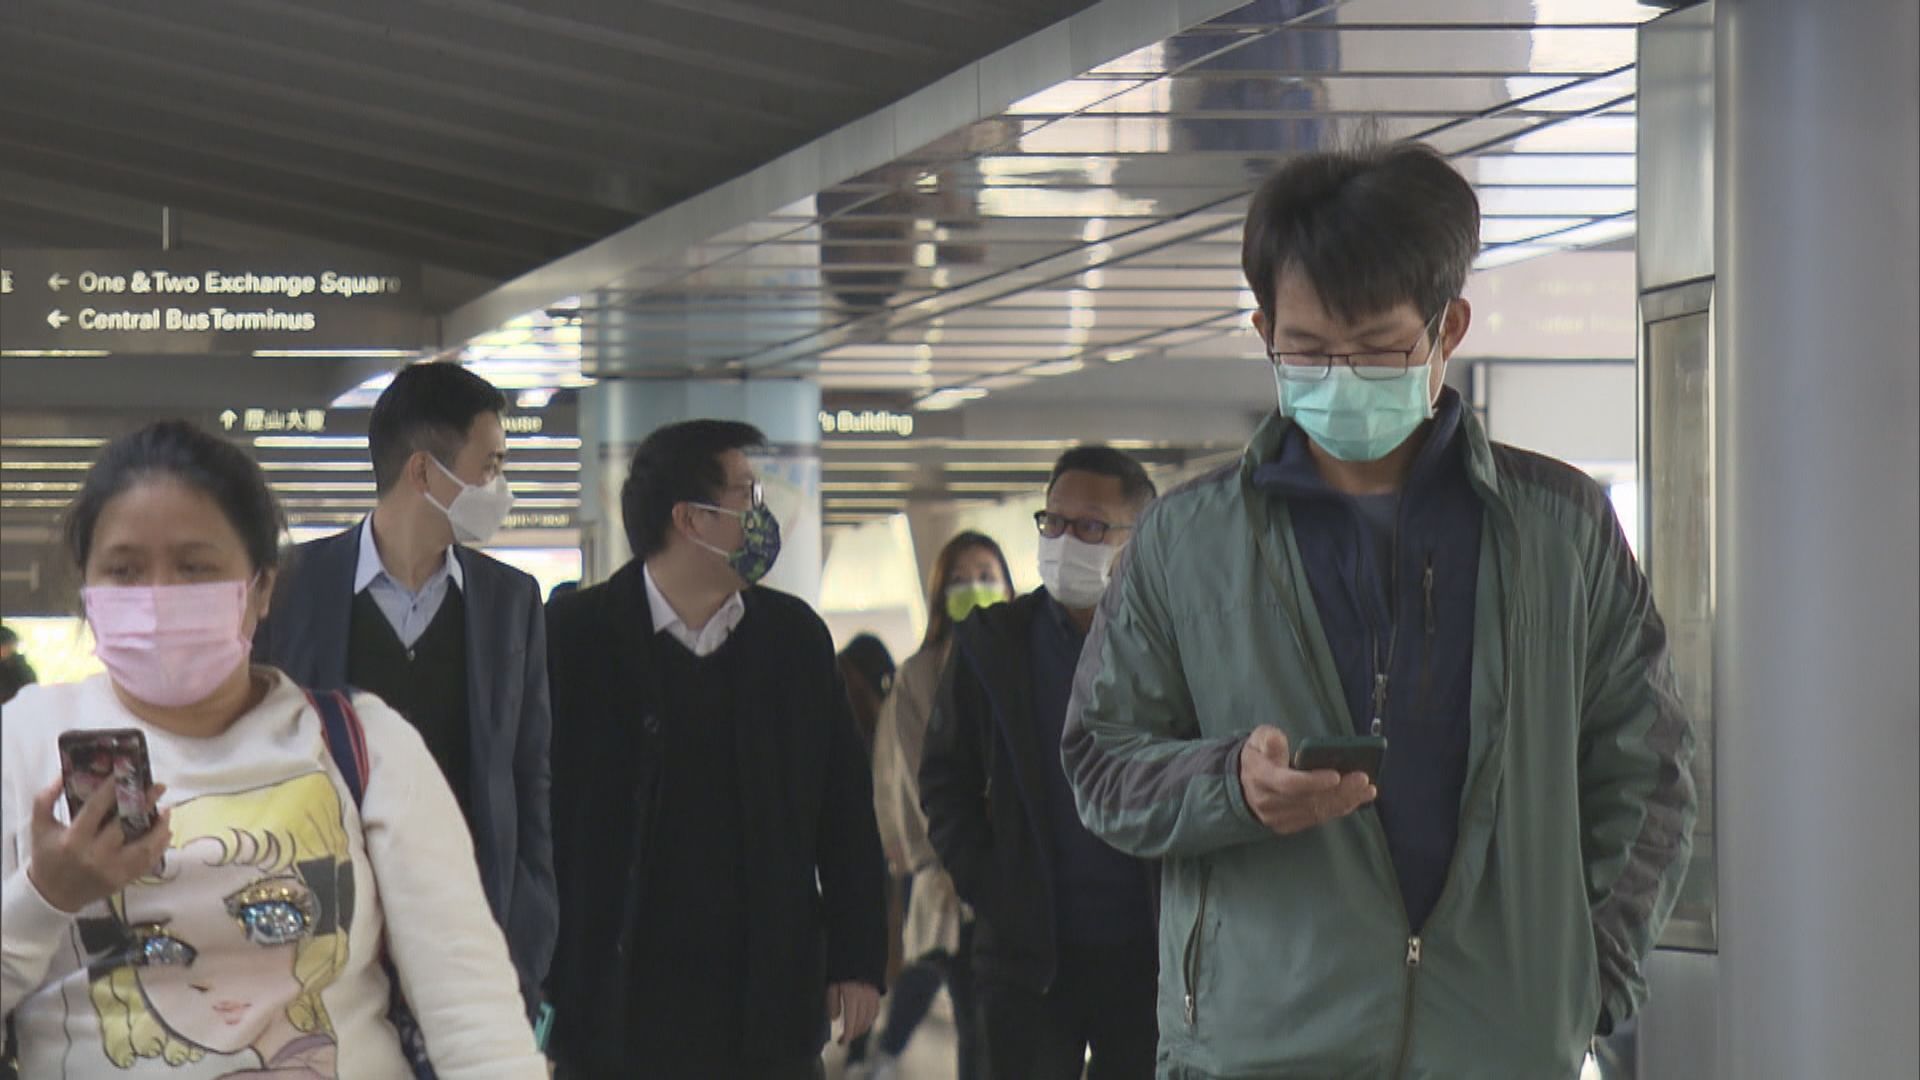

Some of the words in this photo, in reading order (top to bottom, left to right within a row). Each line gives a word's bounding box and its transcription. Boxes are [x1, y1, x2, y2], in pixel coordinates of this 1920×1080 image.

[79, 271, 126, 293] One
[131, 270, 151, 293] &
[152, 271, 200, 293] Two
[205, 271, 316, 297] Exchange
[320, 271, 400, 298] Square
[78, 308, 160, 330] Central
[166, 308, 210, 330] Bus
[209, 308, 315, 330] Terminus
[837, 410, 913, 436] Building
